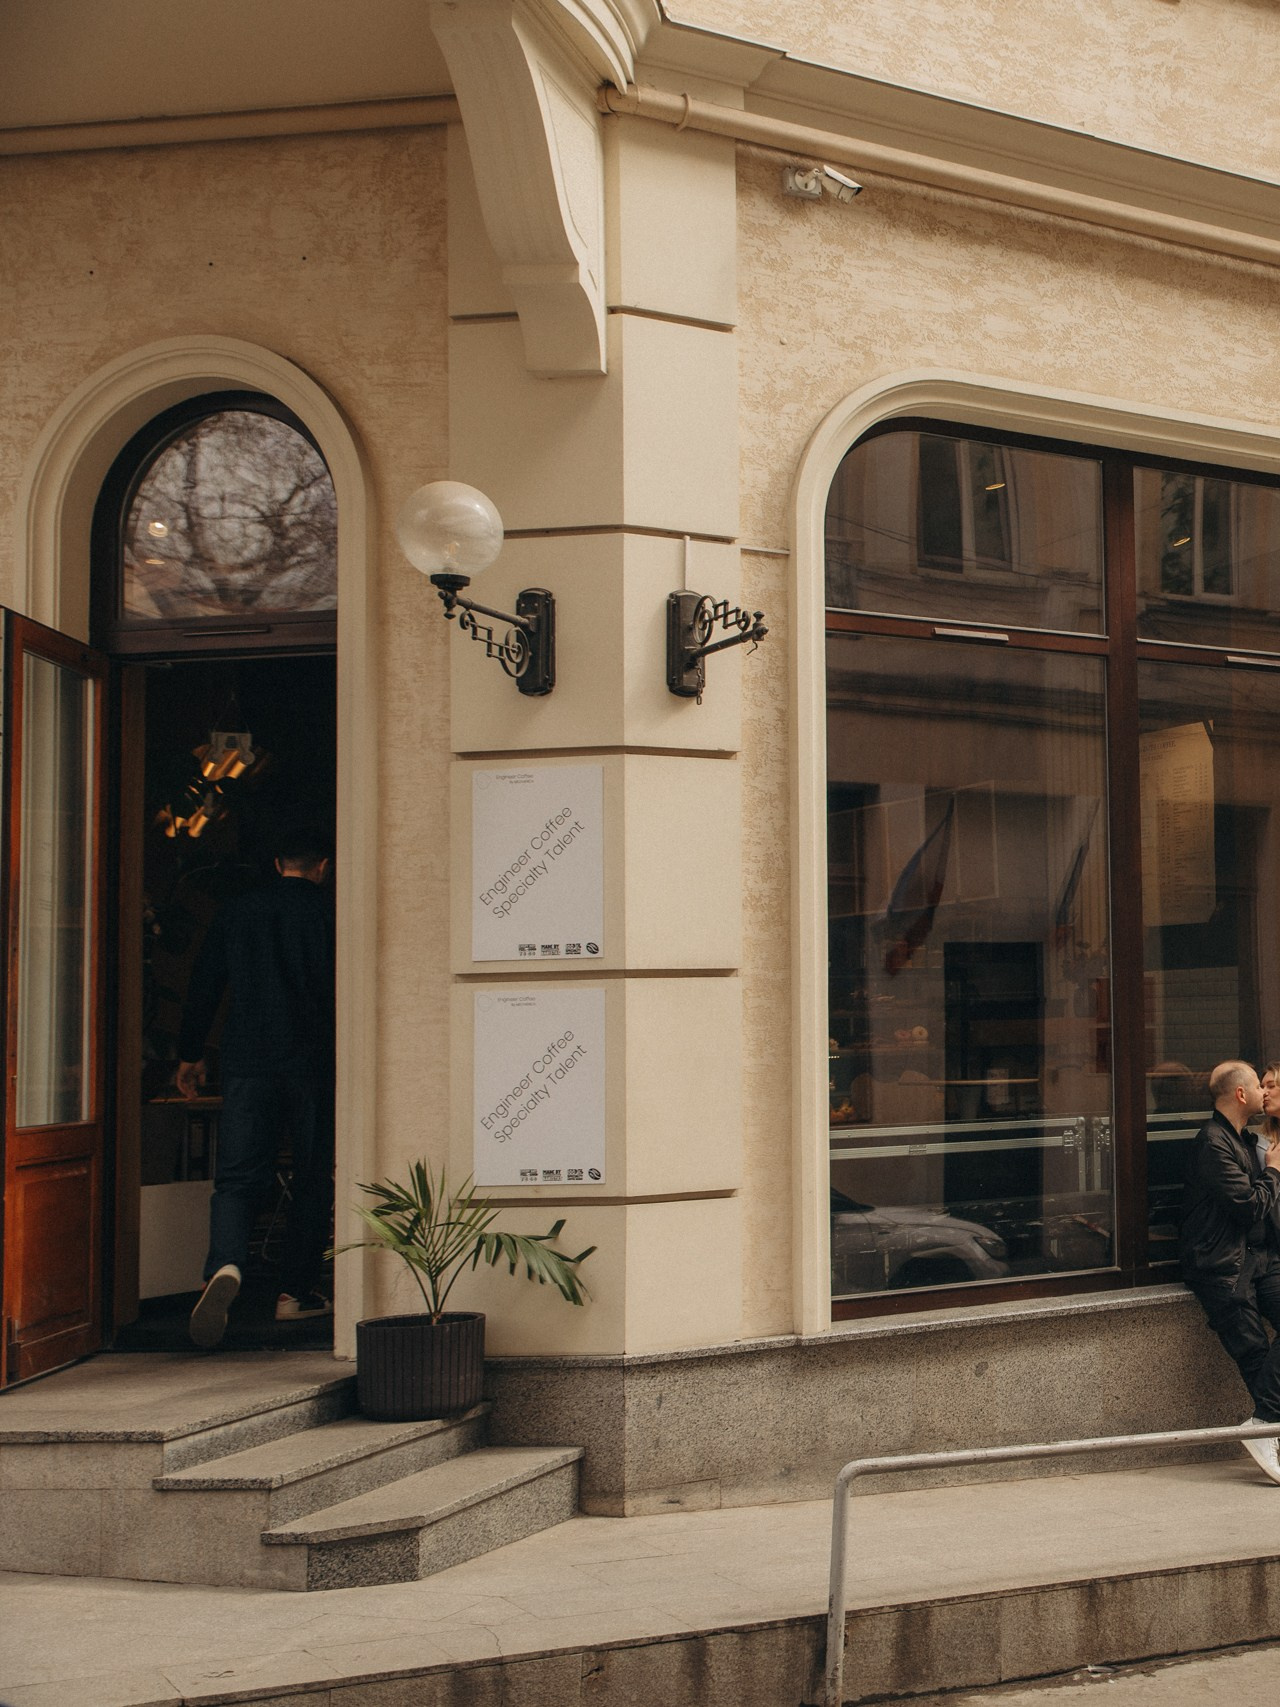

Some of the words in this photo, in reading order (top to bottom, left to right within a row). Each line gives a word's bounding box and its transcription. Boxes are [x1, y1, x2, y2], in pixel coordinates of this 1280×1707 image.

[479, 849, 531, 906] Engineer
[530, 807, 572, 850] Coffee
[492, 860, 549, 919] Specialty
[544, 820, 585, 861] Talent
[480, 1072, 533, 1130] Engineer
[532, 1030, 574, 1074] Coffee
[493, 1084, 551, 1143] Specialty
[545, 1044, 588, 1085] Talent
